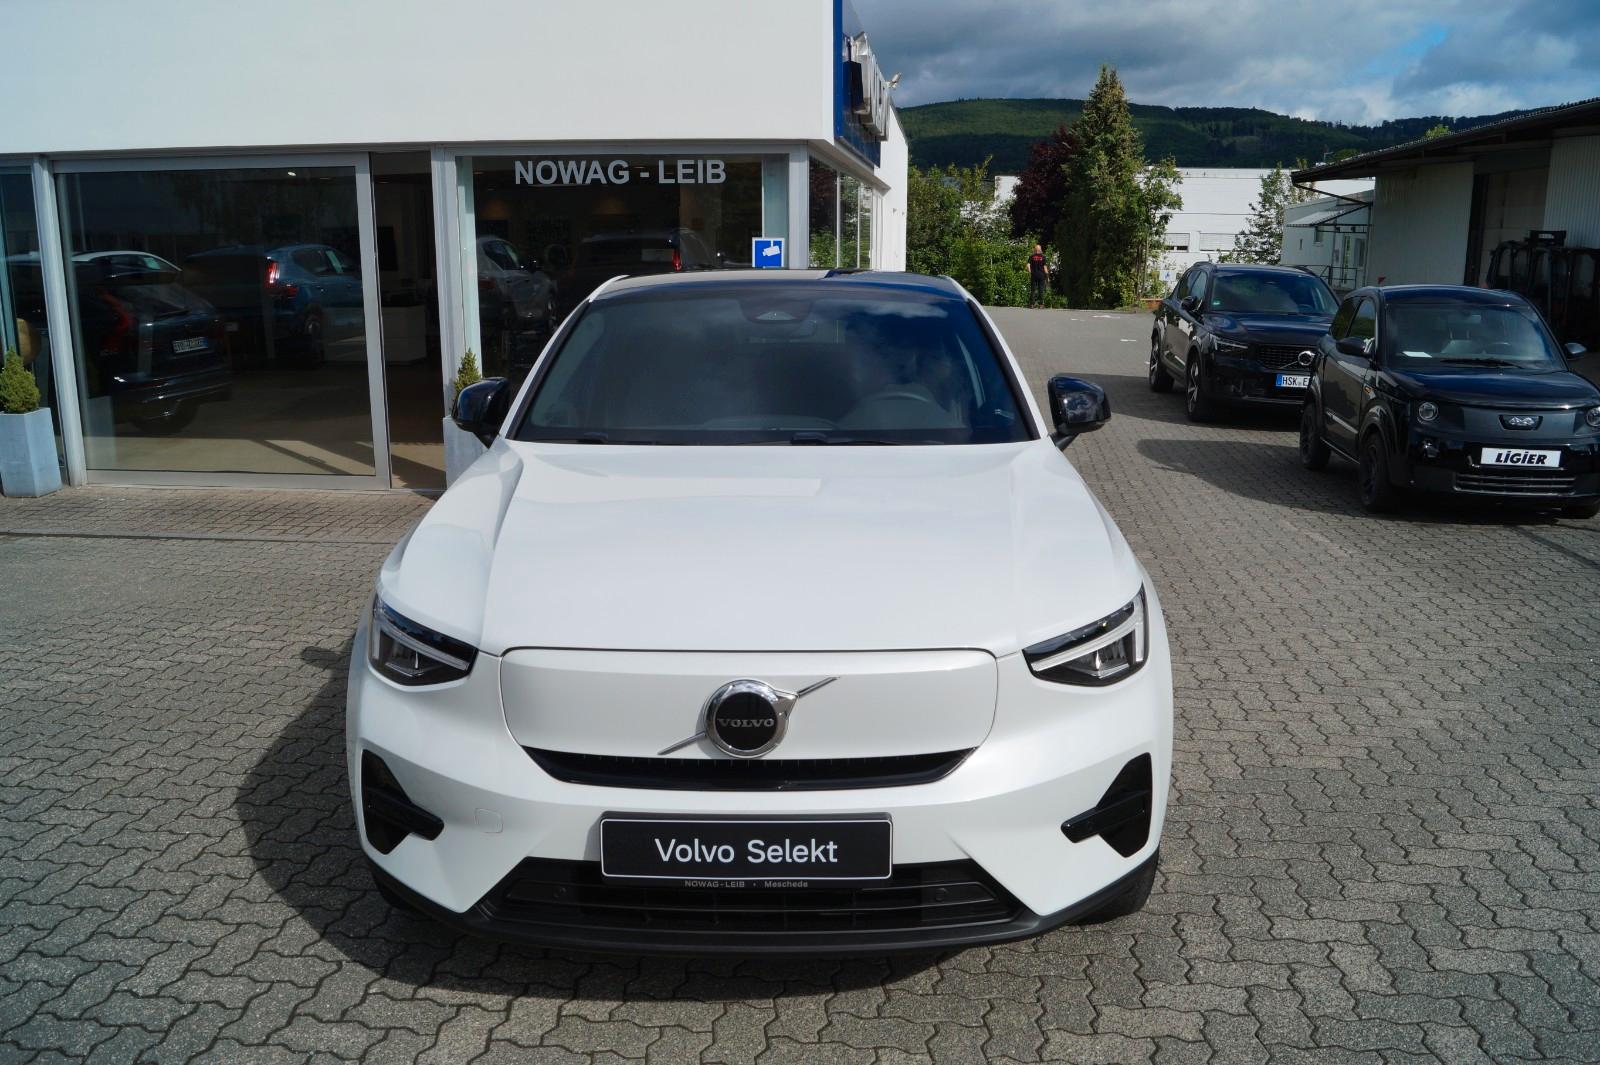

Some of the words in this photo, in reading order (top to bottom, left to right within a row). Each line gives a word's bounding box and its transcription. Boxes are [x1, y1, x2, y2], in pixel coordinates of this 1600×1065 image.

[514, 159, 630, 185] NOWAG
[658, 159, 727, 184] LEIB
[1282, 376, 1297, 386] HSK
[717, 718, 775, 728] VOLVO
[654, 838, 735, 863] Volvo
[747, 838, 838, 863] Selekt
